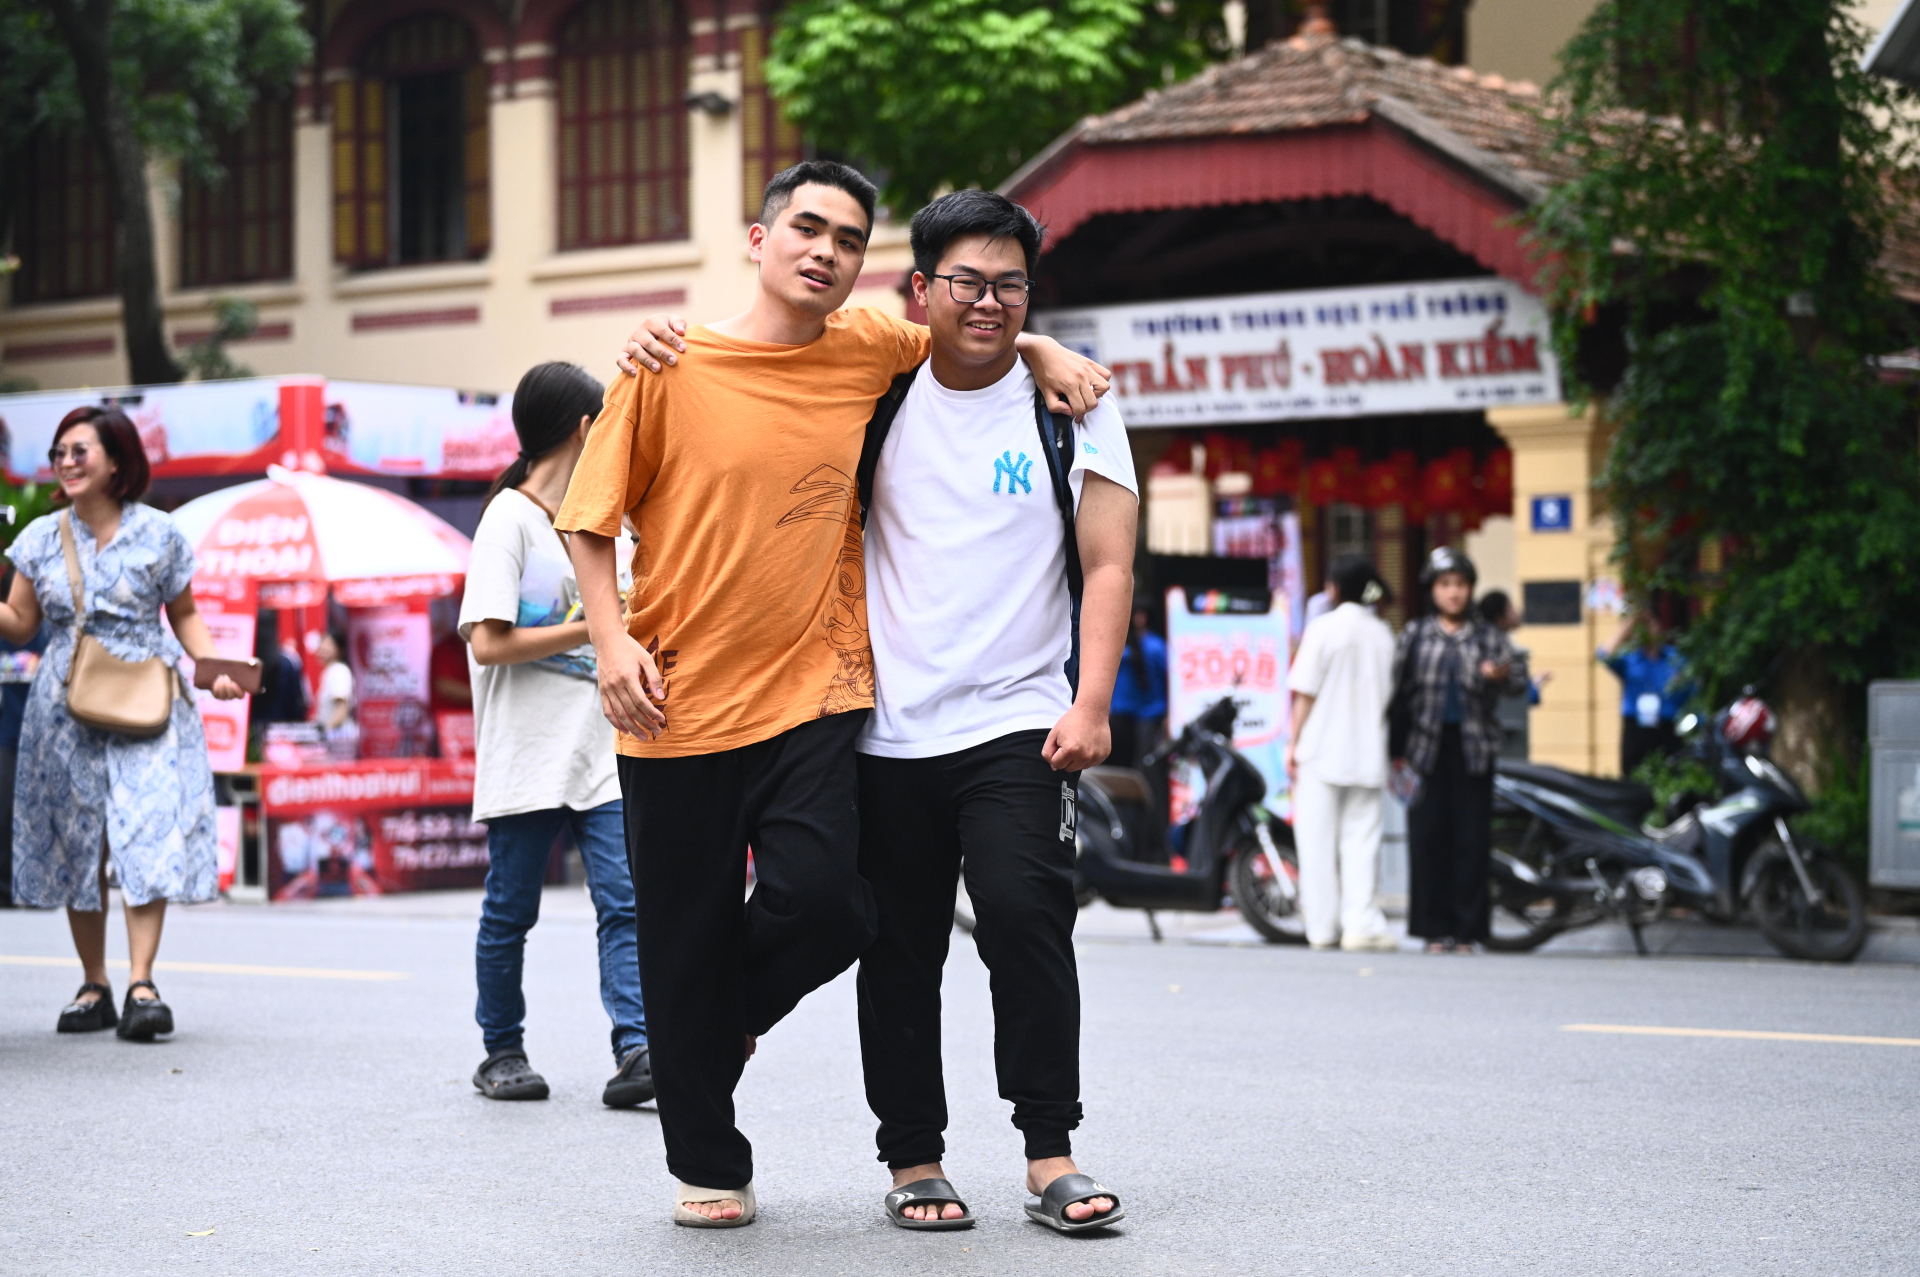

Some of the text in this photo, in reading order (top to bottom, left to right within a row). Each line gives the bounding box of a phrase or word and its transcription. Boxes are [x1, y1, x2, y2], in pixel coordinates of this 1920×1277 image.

[1111, 339, 1210, 397] TRẦN
[1219, 339, 1292, 391] PHÚ
[1319, 333, 1427, 387] HOÀN
[1435, 318, 1542, 377] KIẾM
